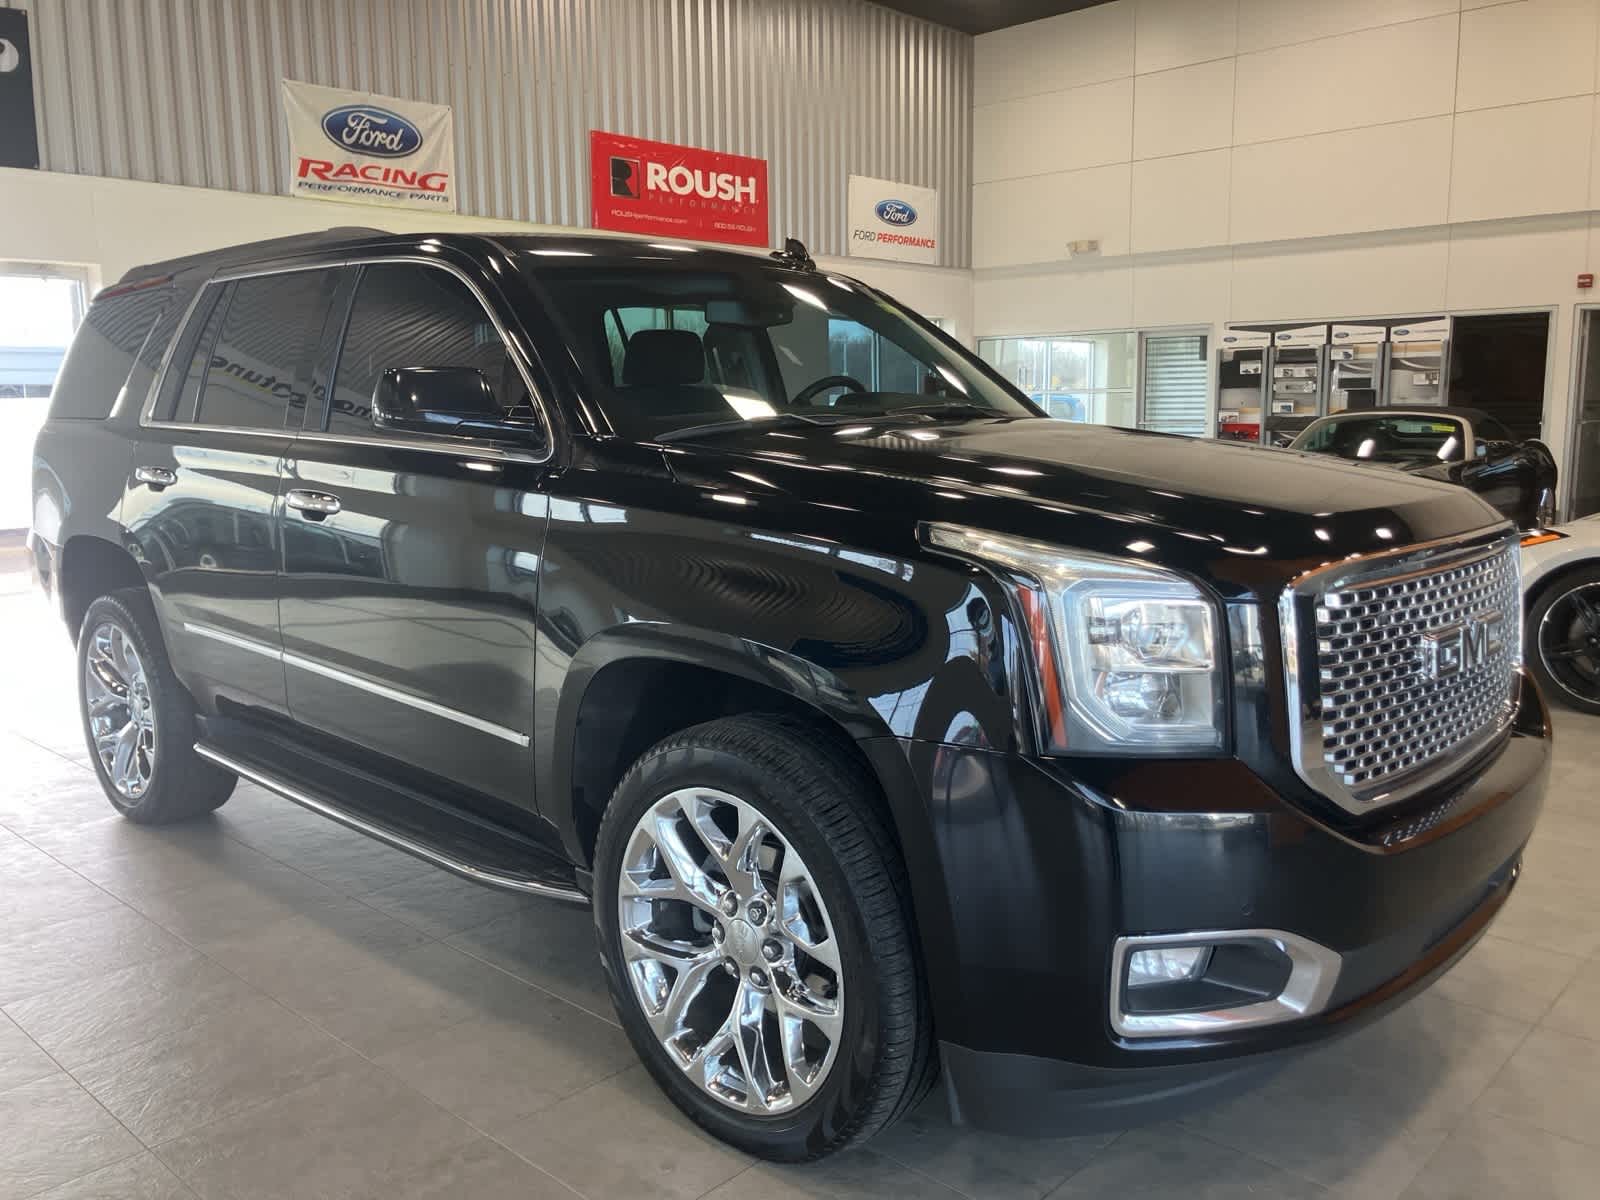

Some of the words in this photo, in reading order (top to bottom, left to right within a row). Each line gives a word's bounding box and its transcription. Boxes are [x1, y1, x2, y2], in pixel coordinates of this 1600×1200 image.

[342, 112, 403, 150] Ford
[298, 157, 449, 193] RACING
[298, 181, 407, 201] PERFORMANCE
[409, 192, 449, 203] PARTS
[647, 161, 757, 204] ROUSH
[883, 203, 910, 223] Ford
[853, 229, 876, 242] FORD
[877, 232, 936, 249] PERFORMANCE
[1421, 608, 1504, 680] GMC
